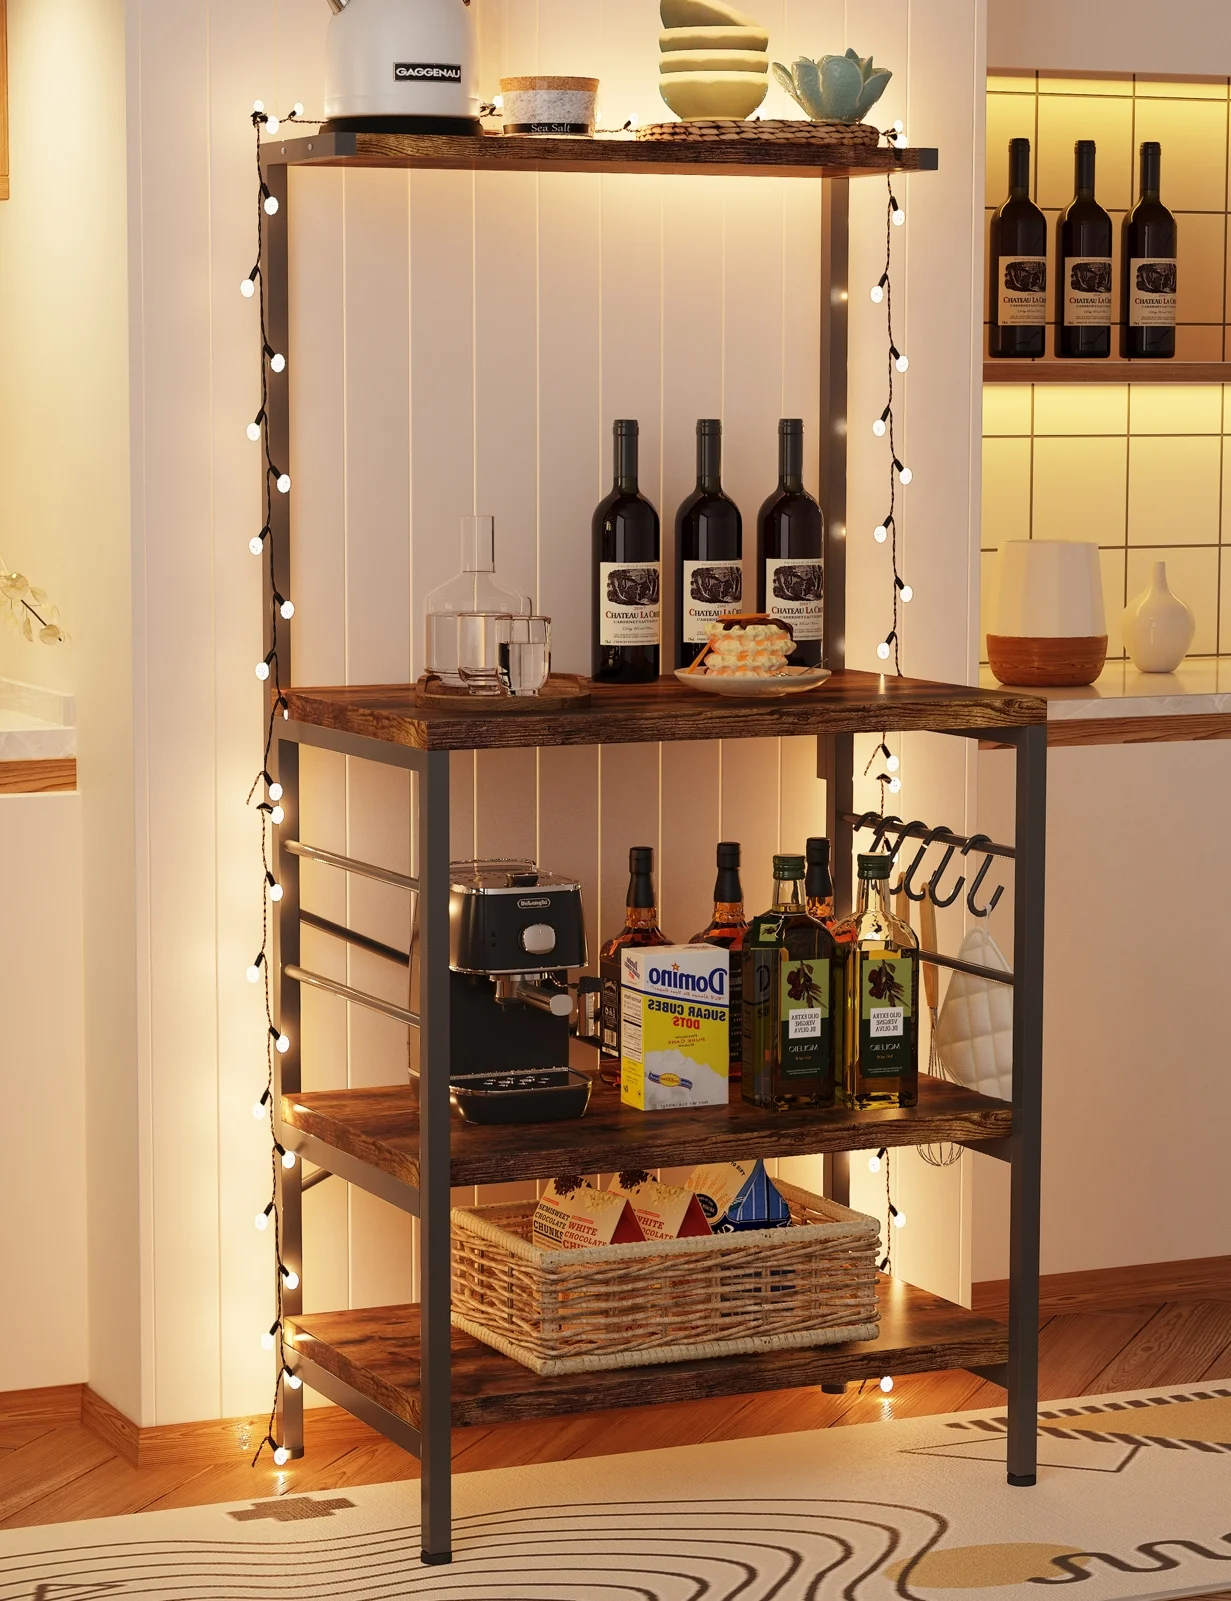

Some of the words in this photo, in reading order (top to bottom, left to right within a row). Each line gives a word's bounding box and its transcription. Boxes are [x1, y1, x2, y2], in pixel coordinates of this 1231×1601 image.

[395, 67, 460, 78] GAGGENAU
[530, 124, 548, 133] Sea
[550, 124, 571, 133] Salt
[606, 611, 639, 619] CHATEAU
[689, 609, 722, 617] CHATEAU
[772, 606, 804, 614] CHATEAU
[806, 606, 813, 614] LA
[736, 1165, 745, 1176] SIFT
[539, 1204, 570, 1221] SEMISWEET
[535, 1211, 566, 1229] CHOCOLATE
[568, 1221, 598, 1236] WHITE
[564, 1231, 607, 1246] CHOCOLATE
